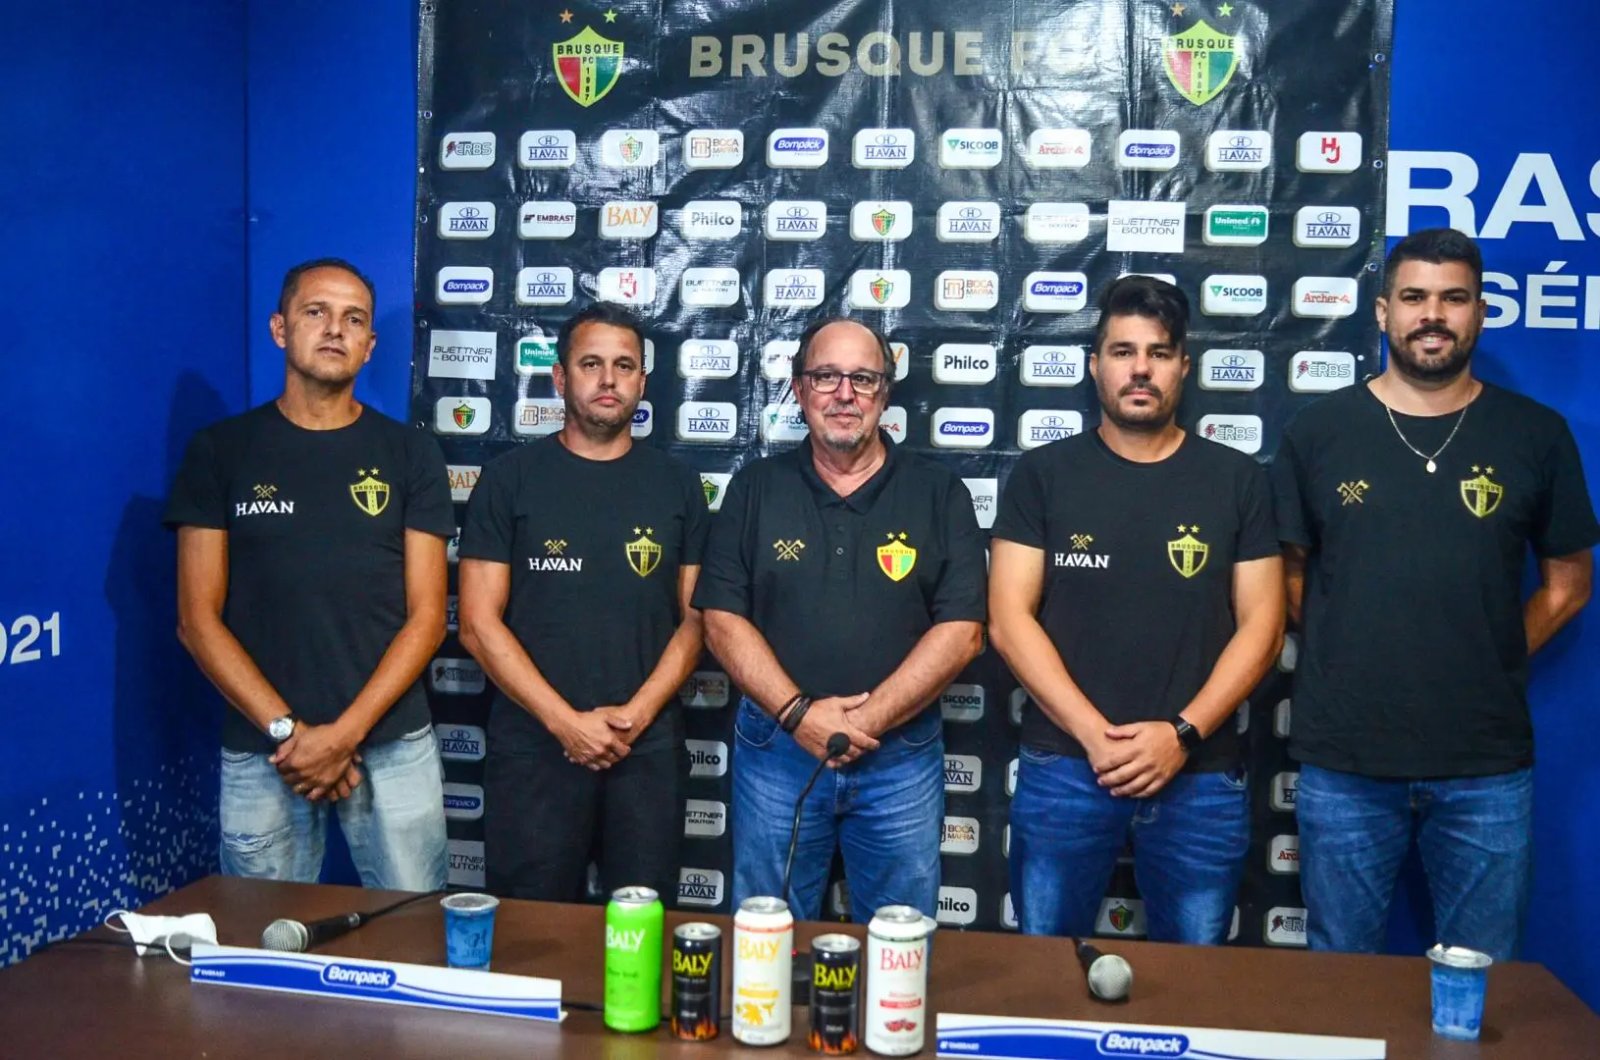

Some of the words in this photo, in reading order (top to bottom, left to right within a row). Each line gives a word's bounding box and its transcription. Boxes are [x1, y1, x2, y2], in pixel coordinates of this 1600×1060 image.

[1170, 38, 1234, 48] RUSQUE
[557, 44, 620, 55] BRUSQUE
[689, 31, 983, 78] BRUSQUE
[1011, 31, 1092, 75] F
[1194, 51, 1207, 59] FC
[455, 142, 492, 156] ERBS
[777, 139, 821, 150] Bompack
[960, 141, 998, 150] SICOOB
[529, 148, 568, 158] HAVAN
[866, 148, 906, 158] HAVAN
[1128, 146, 1172, 157] Bompack
[1218, 150, 1262, 160] HAVAN
[1386, 151, 1600, 241] RA
[607, 206, 654, 227] BALY
[691, 212, 734, 226] Philco
[1112, 218, 1179, 226] BUETTNER
[1215, 217, 1248, 225] Unimed
[450, 220, 488, 229] HAVAN
[776, 220, 818, 229] HAVAN
[949, 221, 991, 231] HAVAN
[1121, 227, 1175, 235] BOUTON
[1307, 226, 1350, 236] HAVAN
[447, 281, 486, 292] Bompack
[528, 285, 565, 295] HAVAN
[1033, 283, 1078, 294] Bompack
[776, 288, 816, 297] HAVAN
[1223, 288, 1263, 297] SICOOB
[1303, 293, 1338, 303] Archer
[1481, 261, 1600, 330] SÉ
[434, 346, 492, 355] BUETTNER
[441, 354, 489, 363] BOUTON
[690, 358, 730, 369] HAVAN
[944, 355, 989, 370] Philco
[1033, 365, 1076, 375] HAVAN
[1211, 369, 1255, 379] HAVAN
[1309, 363, 1351, 378] ERBS
[688, 420, 729, 430] HAVAN
[943, 423, 985, 434] Bompack
[1031, 430, 1074, 440] HAVAN
[1215, 427, 1257, 441] ERBS
[236, 501, 294, 516] HAVAN
[528, 558, 583, 572] HAVAN
[1055, 553, 1110, 568] HAVAN
[0, 612, 60, 665] 21
[442, 741, 480, 754] HAVAN
[944, 772, 973, 784] AVAN
[686, 811, 723, 819] ETTNER
[948, 825, 975, 833] BOCA
[606, 925, 645, 953] BALY
[738, 937, 780, 962] BALY
[673, 950, 713, 976] BALY
[880, 946, 924, 970] BALY
[328, 966, 390, 987] Bompack
[815, 963, 857, 988] BALY
[1106, 1034, 1182, 1054] Bompack
